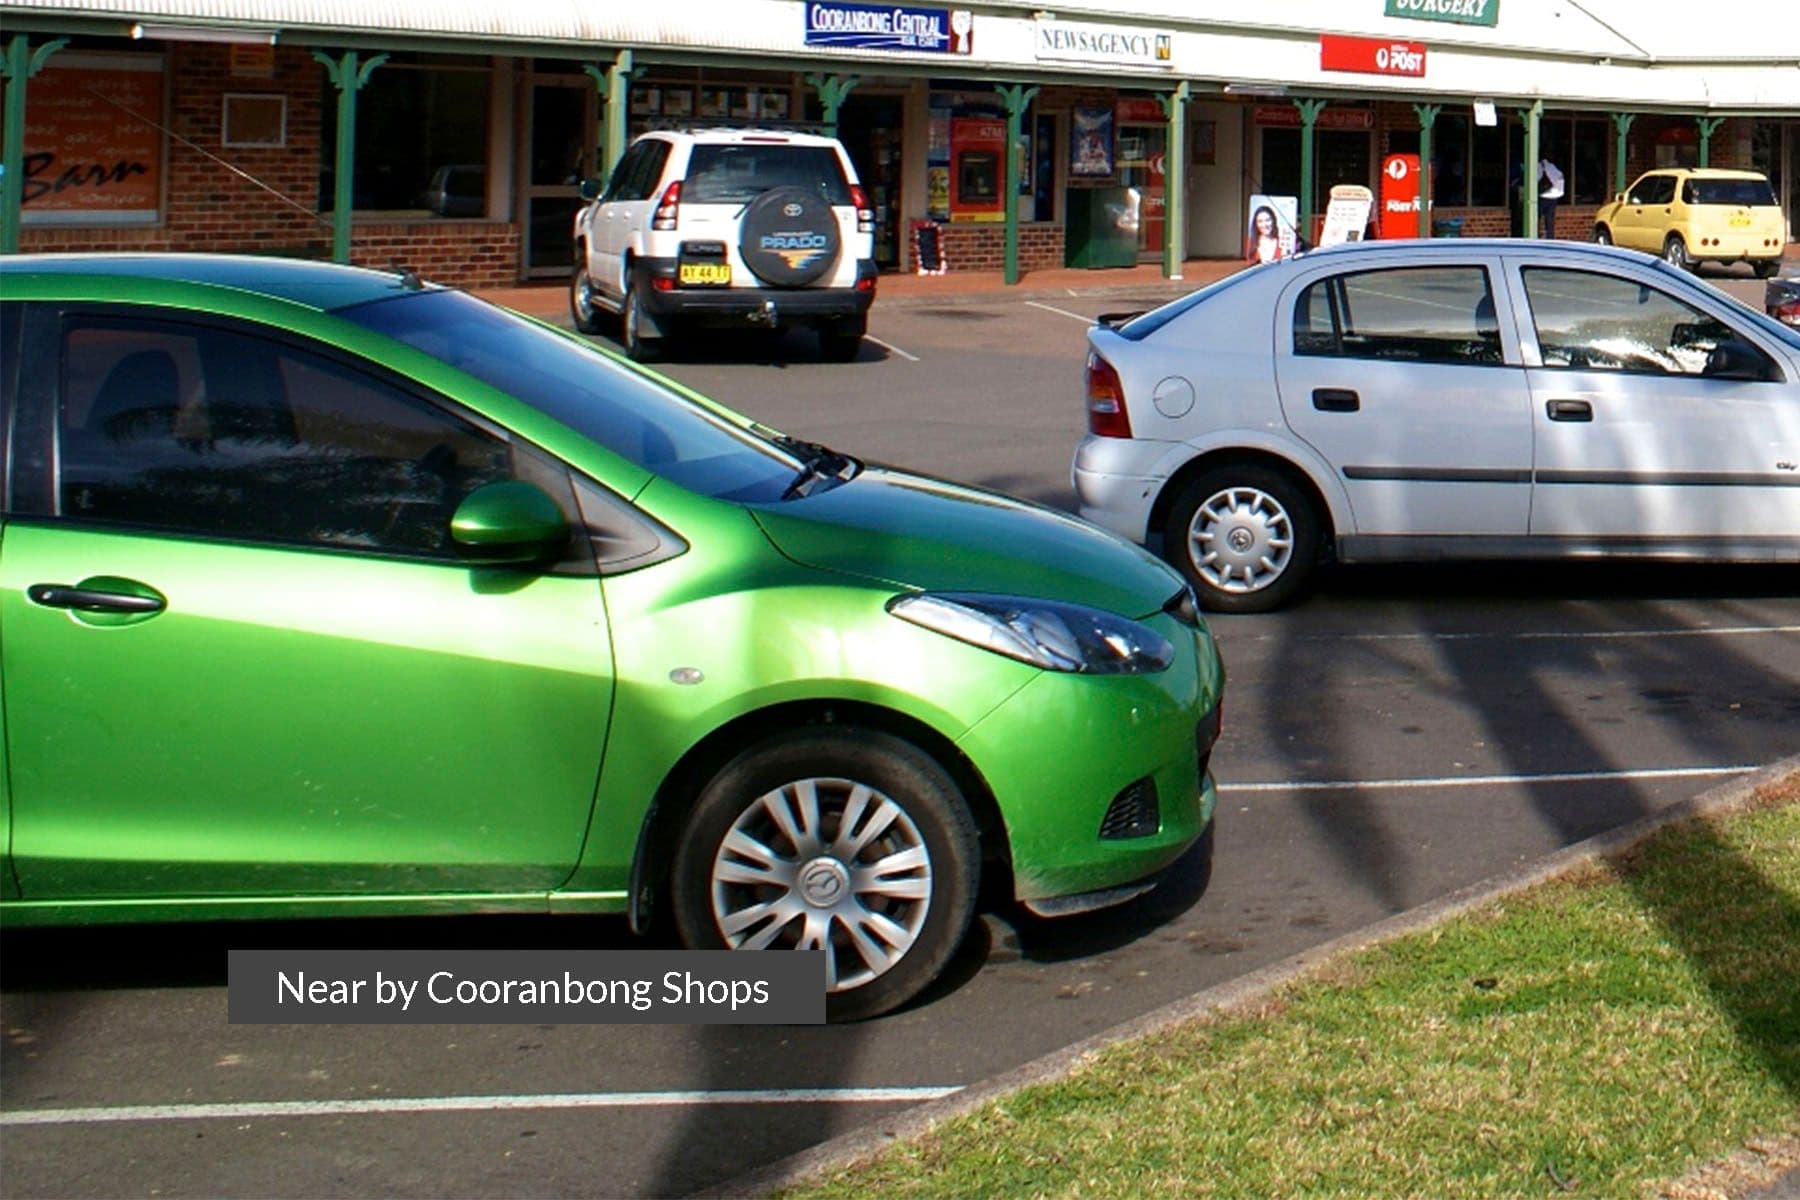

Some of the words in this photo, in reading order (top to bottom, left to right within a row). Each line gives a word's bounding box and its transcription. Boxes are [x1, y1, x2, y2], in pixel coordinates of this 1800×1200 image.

[893, 9, 939, 37] CENTRAL
[1042, 28, 1151, 56] NEWSAGENCY
[1390, 52, 1423, 72] POST
[23, 151, 148, 202] Barn
[760, 235, 827, 249] PRADO
